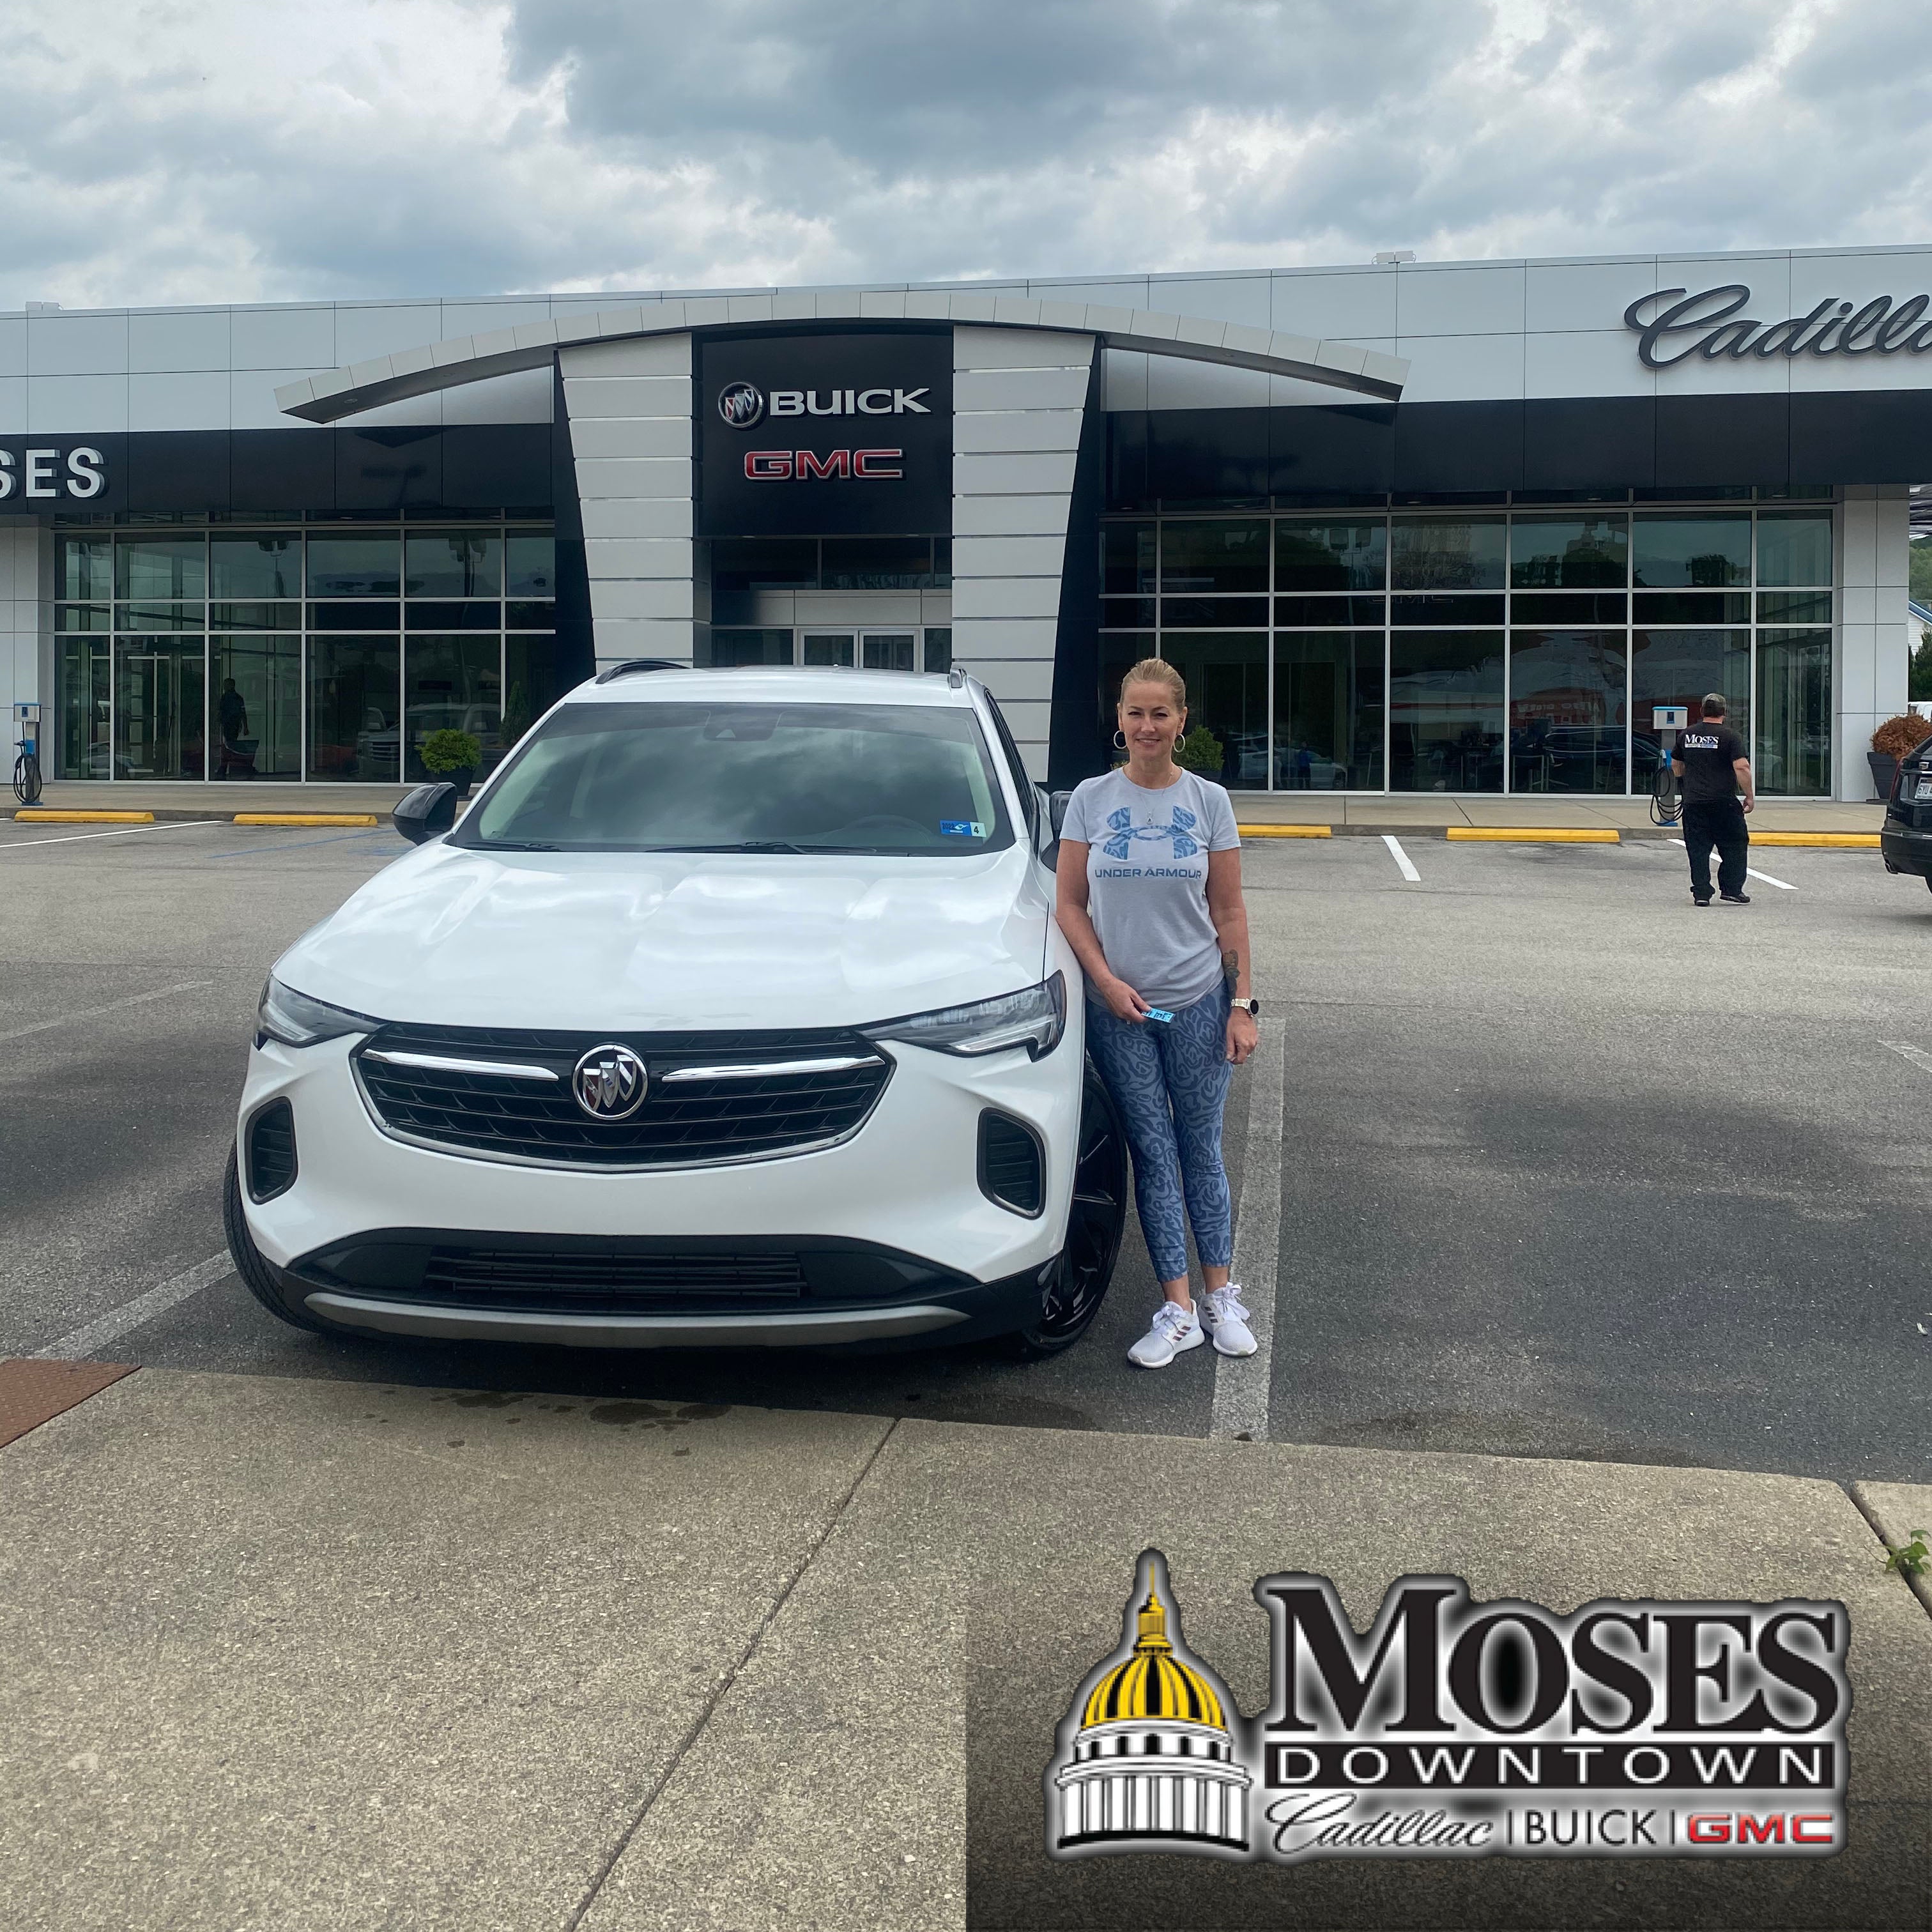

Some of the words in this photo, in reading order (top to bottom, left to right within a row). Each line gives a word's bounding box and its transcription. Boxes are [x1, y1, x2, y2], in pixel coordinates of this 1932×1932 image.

[770, 388, 931, 415] BUICK
[744, 449, 903, 480] GMC
[1685, 734, 1719, 744] MOSES
[1094, 868, 1141, 878] UNDER
[1144, 868, 1202, 879] ARMOUR
